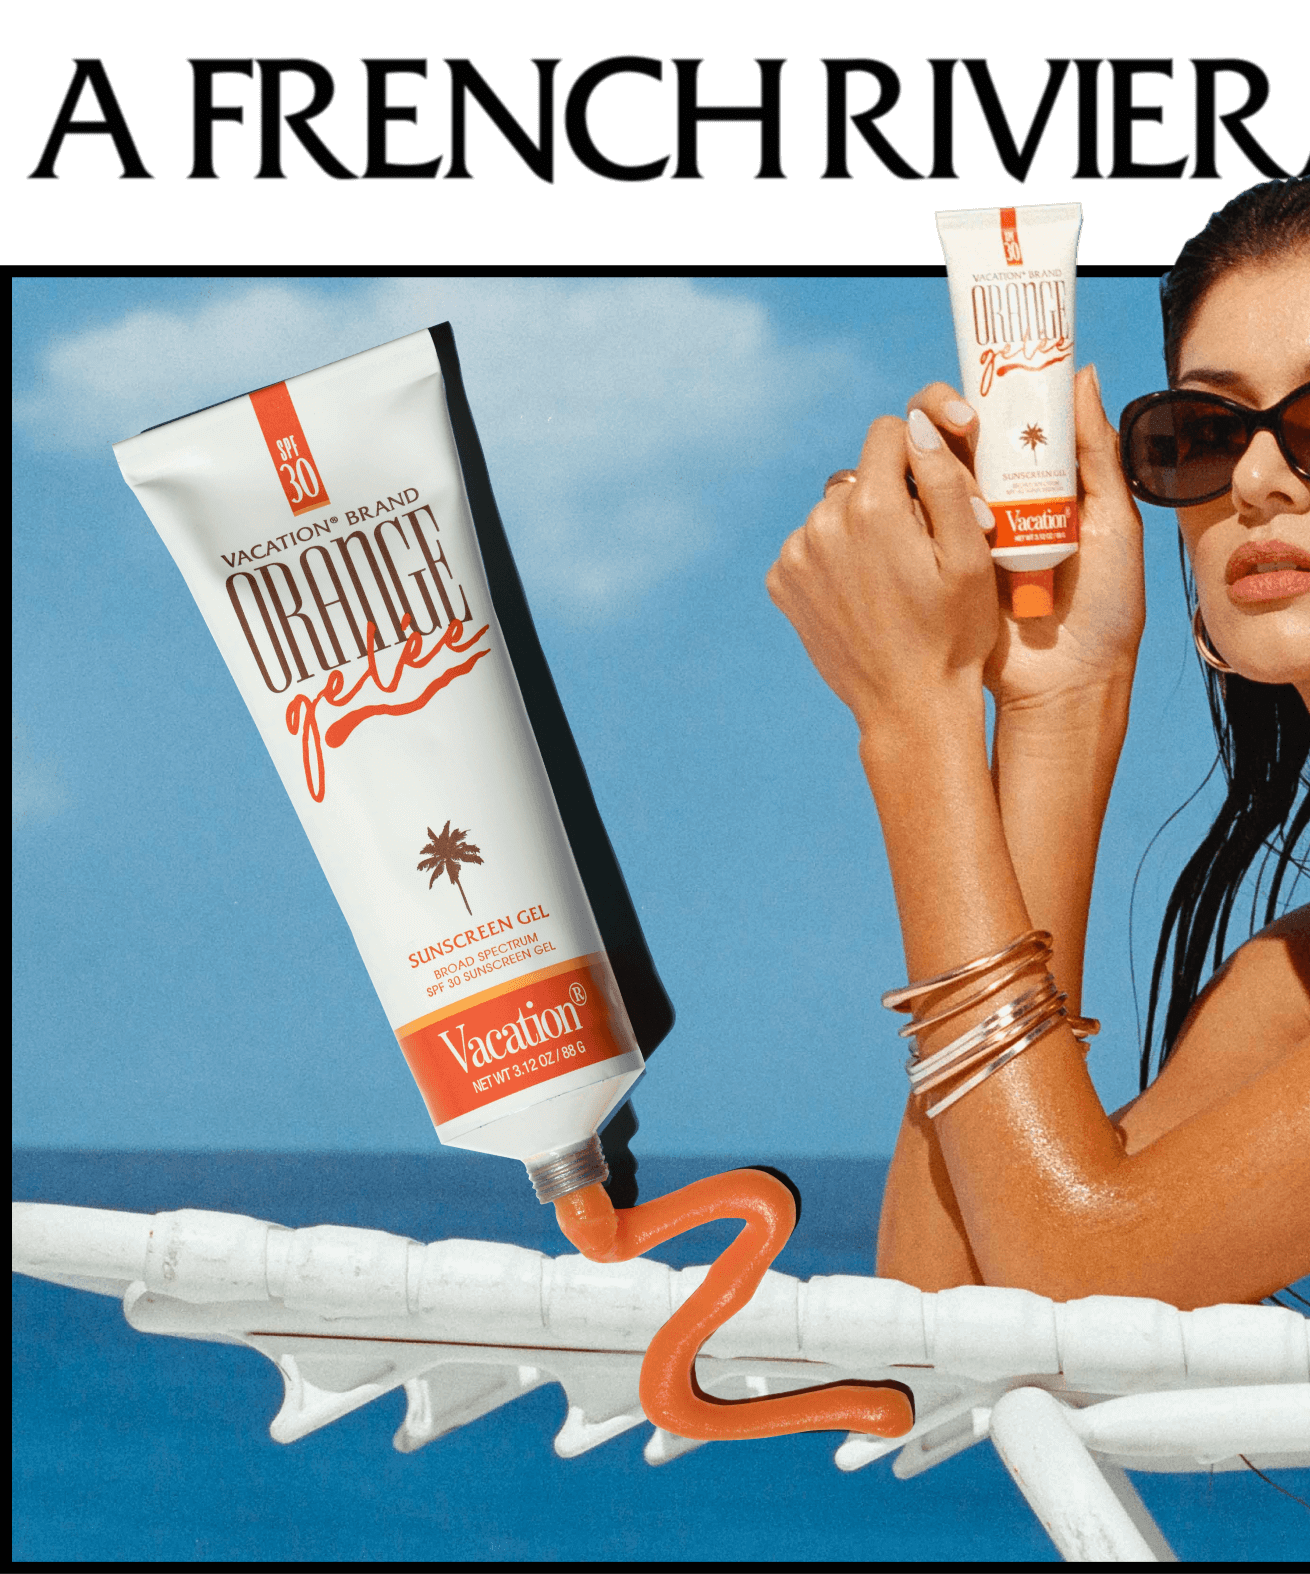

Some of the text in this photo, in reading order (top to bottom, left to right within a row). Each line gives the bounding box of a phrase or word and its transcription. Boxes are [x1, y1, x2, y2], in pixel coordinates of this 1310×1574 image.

[1028, 269, 1063, 279] BRAND
[972, 280, 1070, 346] ORANGE
[276, 435, 300, 461] SPF
[279, 457, 320, 504] 30
[344, 487, 420, 526] BRAND
[225, 504, 474, 694] ORANGE
[285, 612, 490, 804] gelée
[408, 904, 550, 969] SUNSCREEN GEL
[433, 932, 539, 980] BROAD SPECTRUM
[426, 941, 557, 997] SPF 30 SUNSCREEN GEL
[472, 1074, 493, 1094] NET
[492, 1067, 511, 1085] WT
[512, 1058, 538, 1078] 3.12
[538, 1051, 556, 1067] OZ
[561, 1044, 577, 1059] 88
[576, 1040, 587, 1053] G
